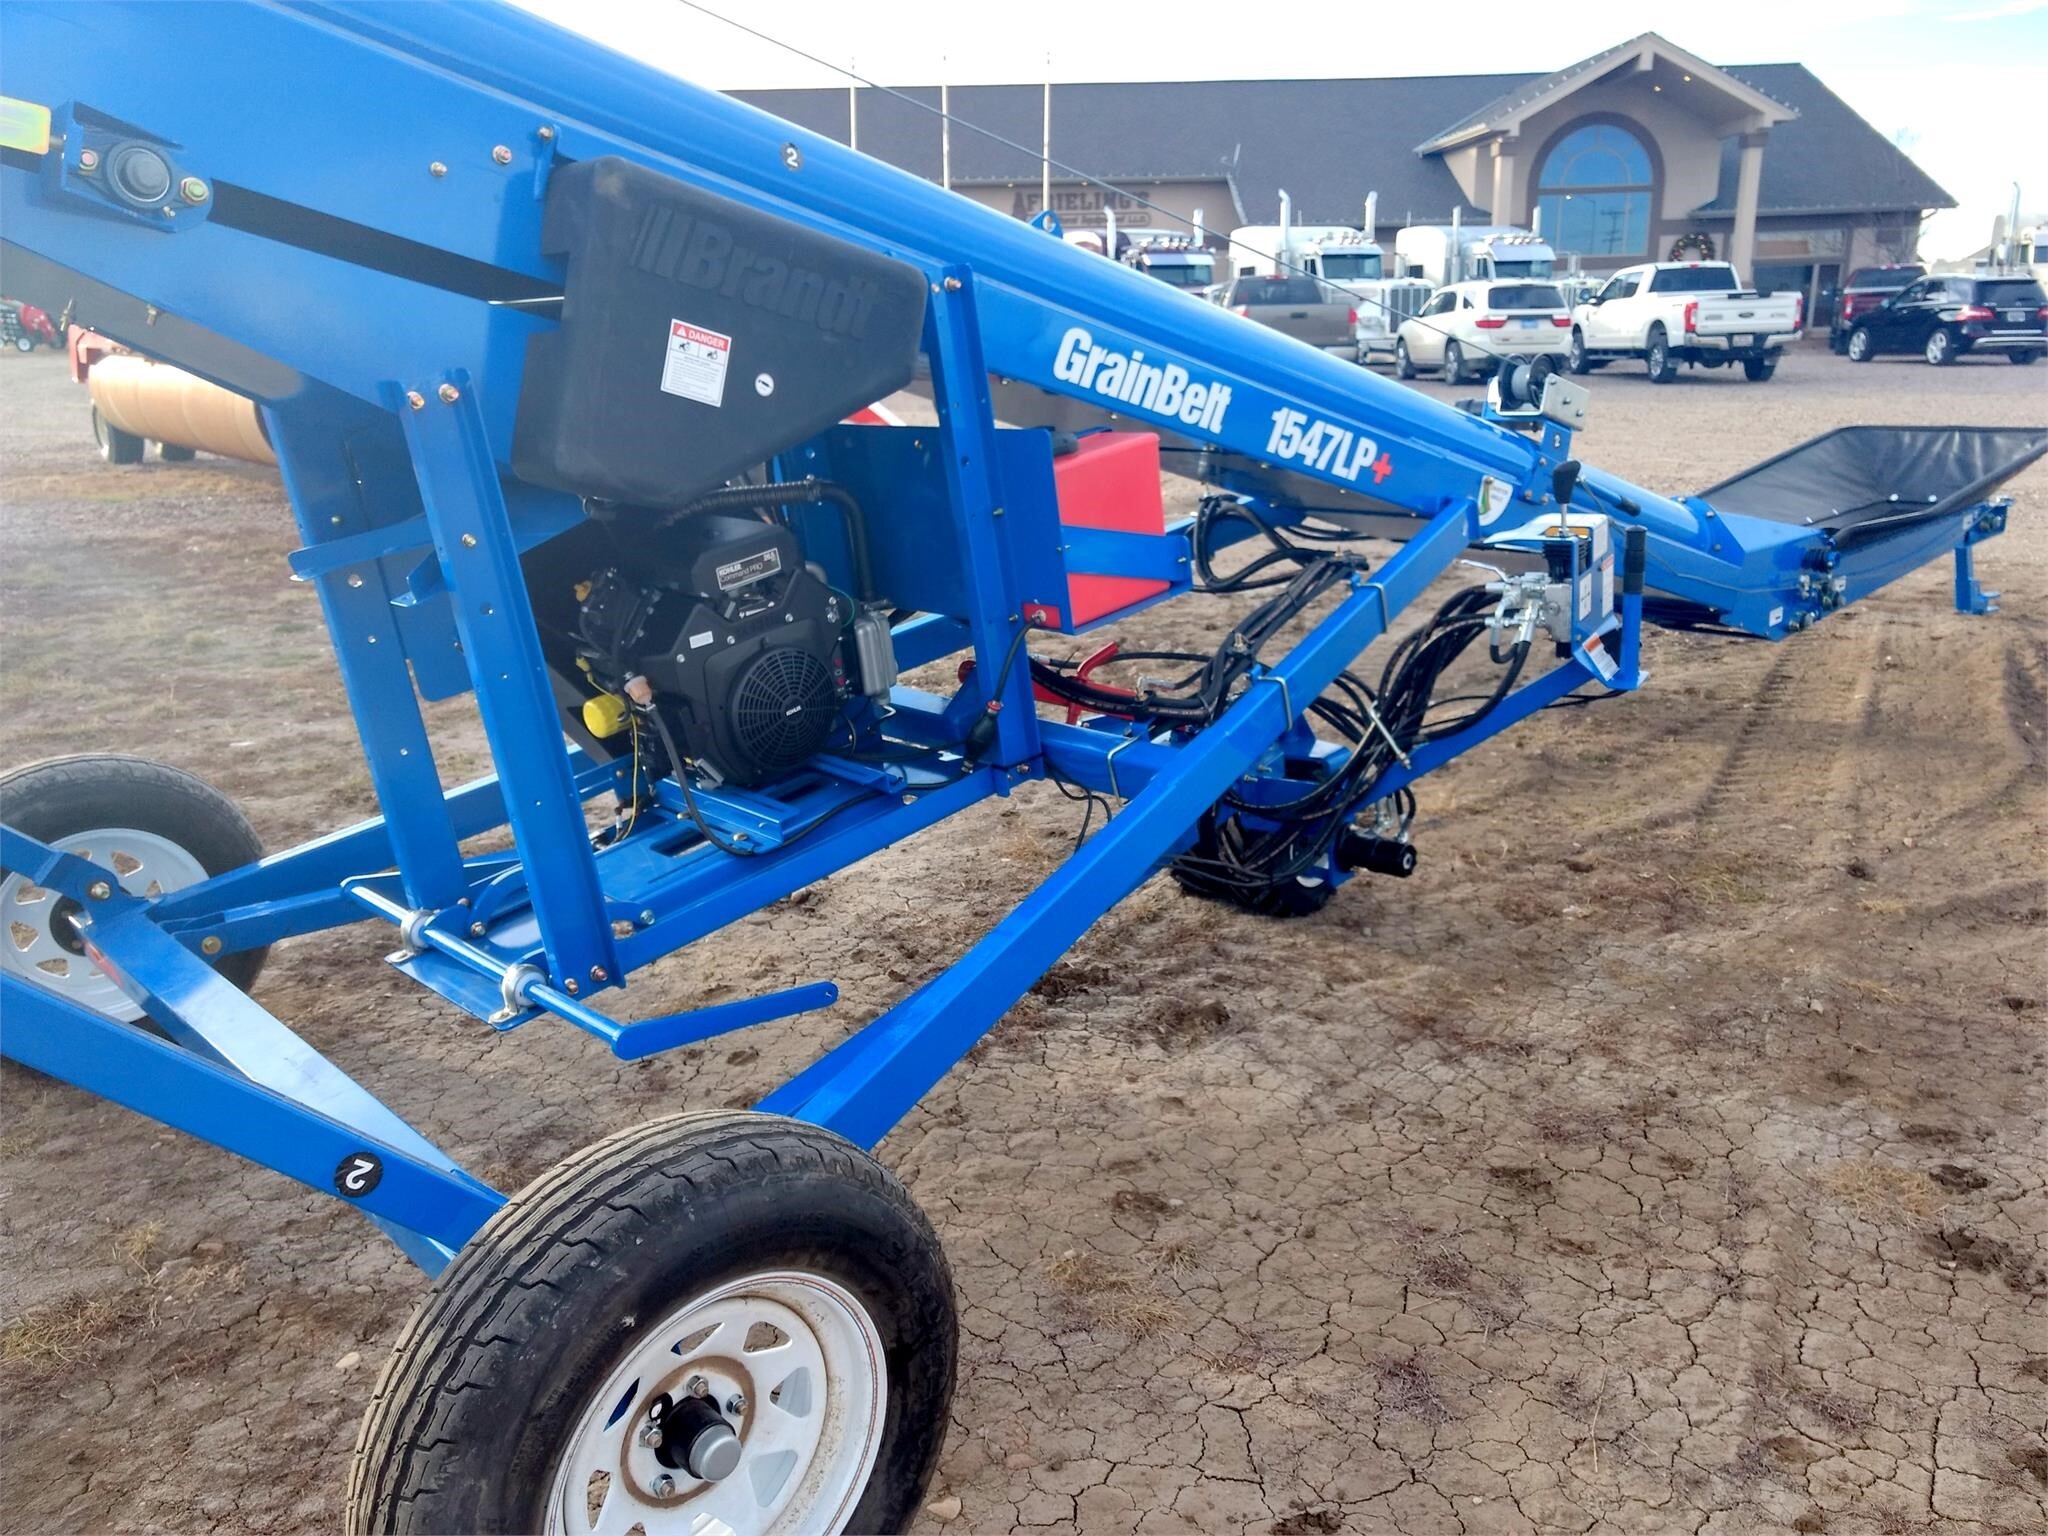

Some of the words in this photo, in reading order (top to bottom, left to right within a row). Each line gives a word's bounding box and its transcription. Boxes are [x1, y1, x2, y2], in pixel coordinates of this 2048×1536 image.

[786, 147, 798, 167] 2
[688, 330, 724, 348] DANGER
[1053, 327, 1232, 434] GrainBelt
[719, 564, 743, 576] KOHLER
[720, 567, 750, 582] Command
[346, 1159, 374, 1190] 2
